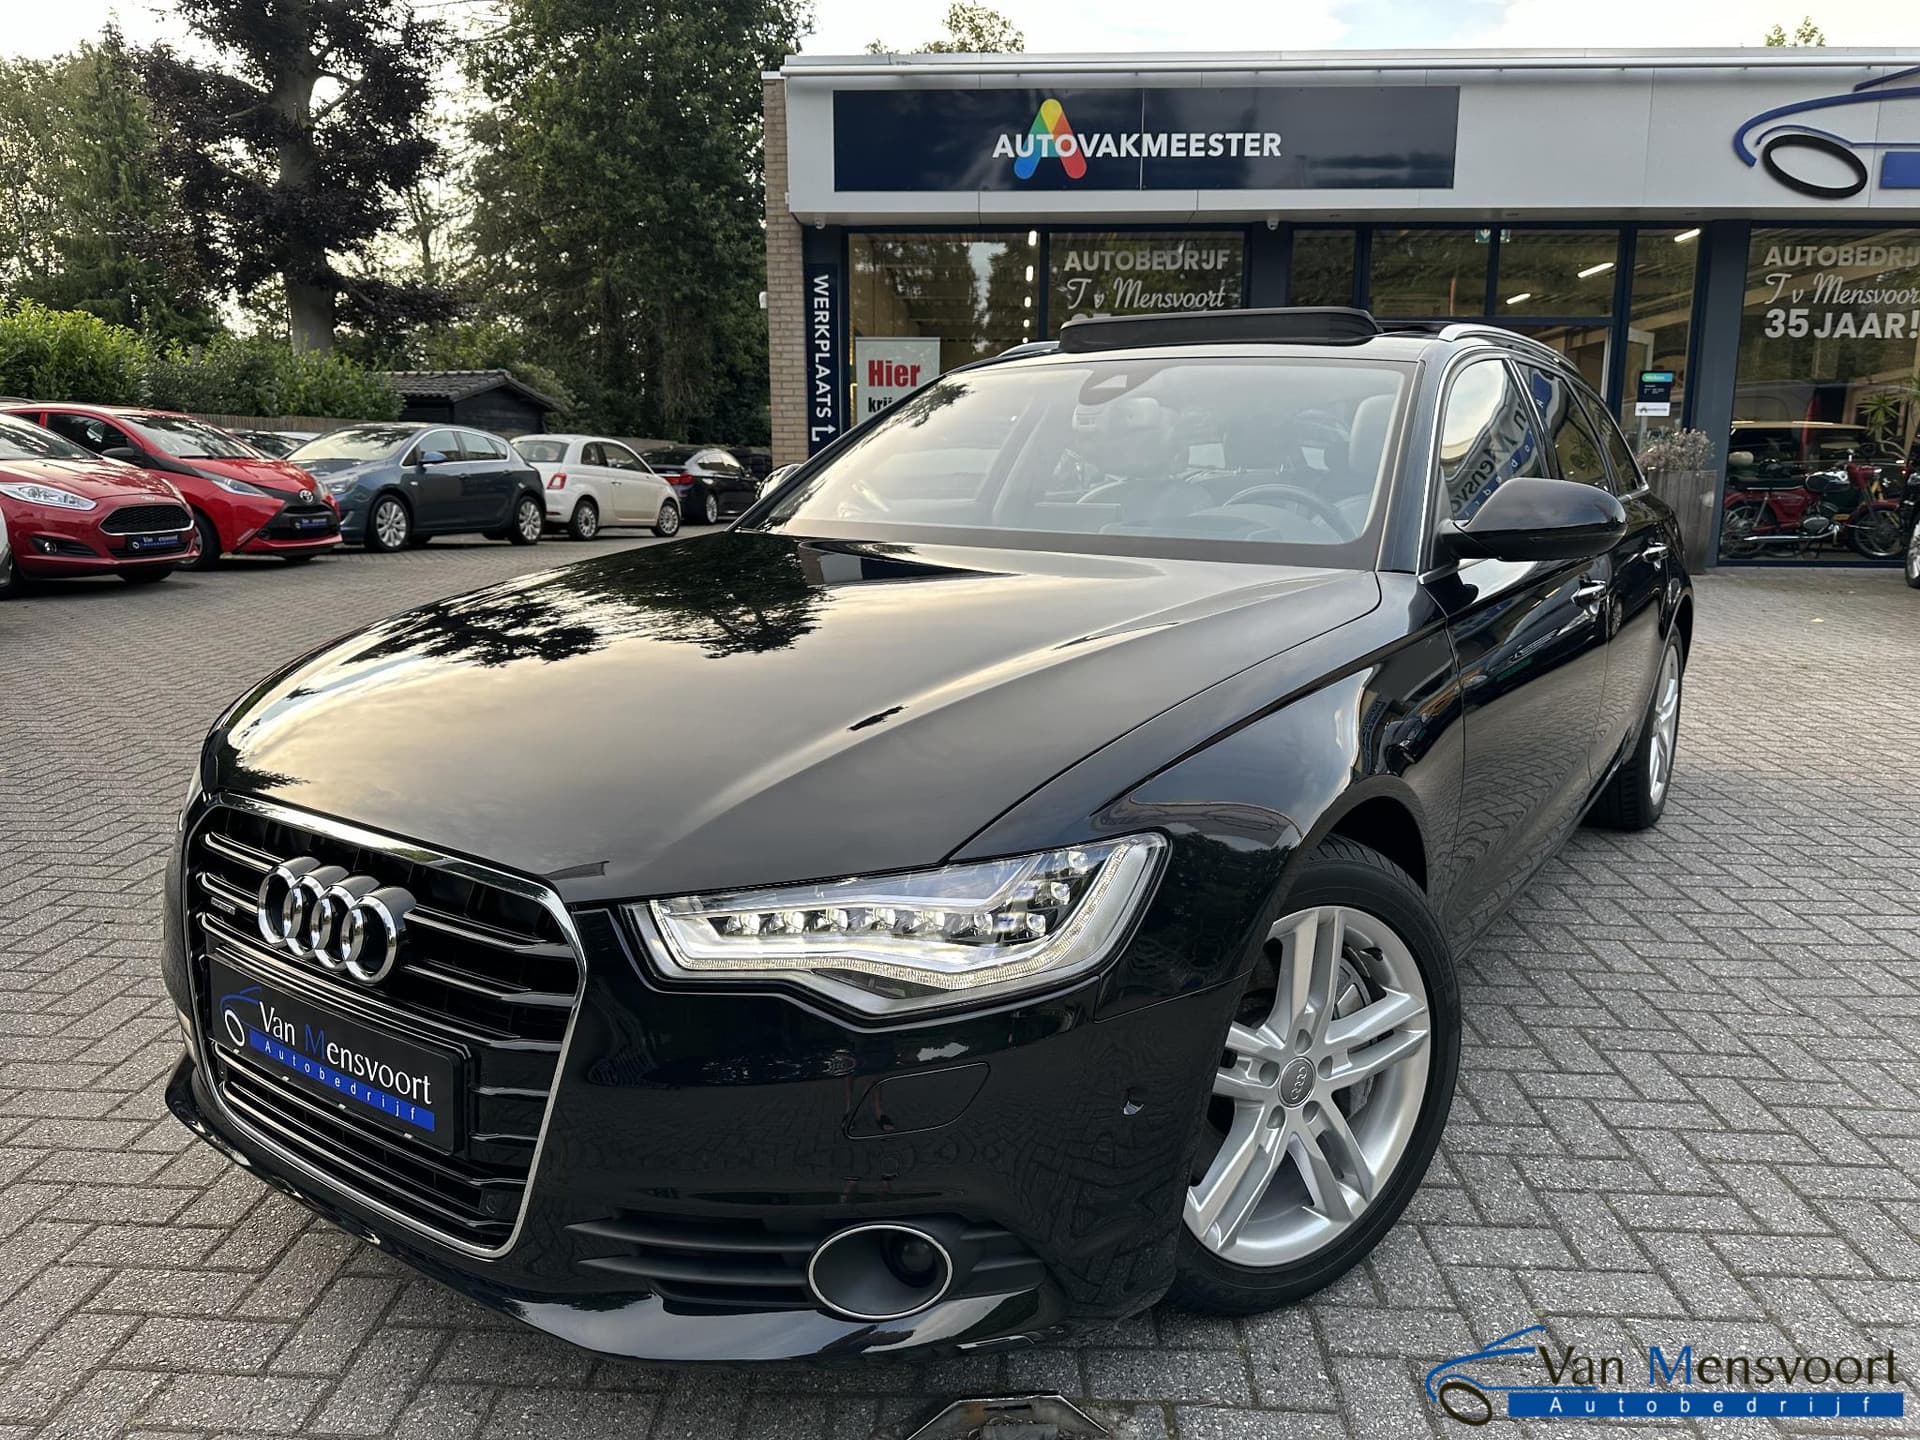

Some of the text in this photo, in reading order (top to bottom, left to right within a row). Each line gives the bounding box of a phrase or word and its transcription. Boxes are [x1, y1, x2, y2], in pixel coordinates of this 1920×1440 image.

[992, 133, 1281, 158] AUTOVAKMEESTER
[1063, 250, 1230, 271] AUTOBEDRIJF
[1763, 246, 1920, 267] AUTOBEDRIJ
[1113, 277, 1226, 309] Mensvoort
[1813, 273, 1920, 305] Mensvoor
[1764, 308, 1920, 339] 35 JAAR!
[813, 274, 832, 419] WERKPLAATS
[868, 360, 921, 388] Hier
[259, 1001, 432, 1105] Van Mensvoort
[264, 1040, 416, 1121] Autobedrijf
